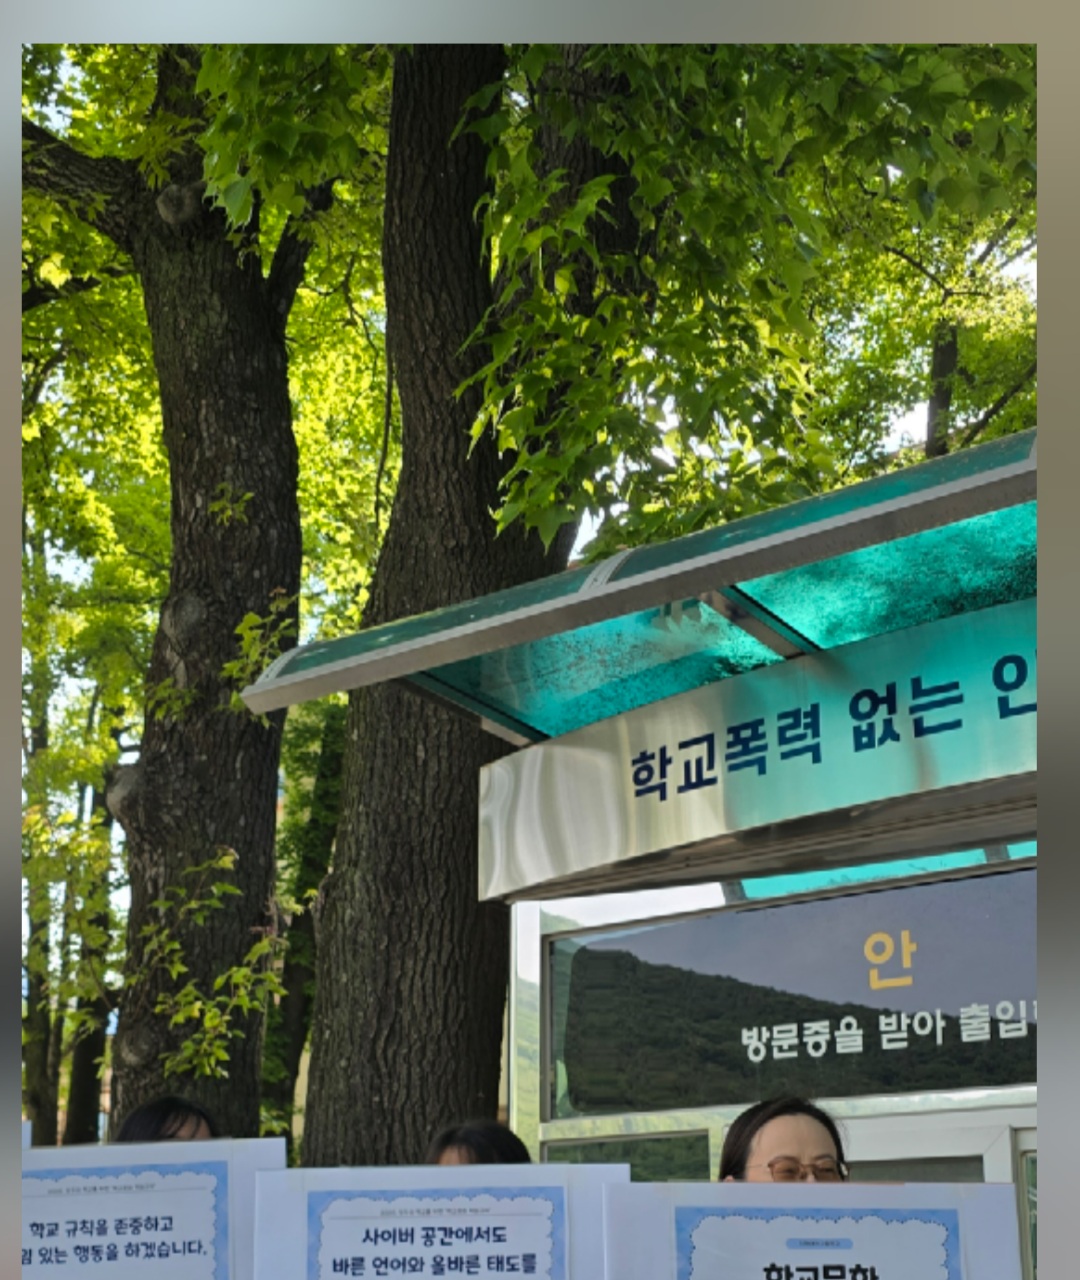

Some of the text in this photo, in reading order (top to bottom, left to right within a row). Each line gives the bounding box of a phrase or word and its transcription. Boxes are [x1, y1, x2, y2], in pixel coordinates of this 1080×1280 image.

[631, 702, 823, 803] 학교폭력
[848, 676, 965, 754] 없는
[864, 929, 918, 991] 안
[741, 999, 1037, 1063] 방문증을 받아 출입
[29, 1215, 174, 1239] 학교 규칙을 존중하고
[362, 1226, 508, 1248] 사이버 공간에서도
[38, 1246, 68, 1265] 있는
[73, 1244, 119, 1263] 행동을
[125, 1240, 208, 1260] 하겠습니다.
[332, 1253, 537, 1276] 바른 언어와 올바른 태도를
